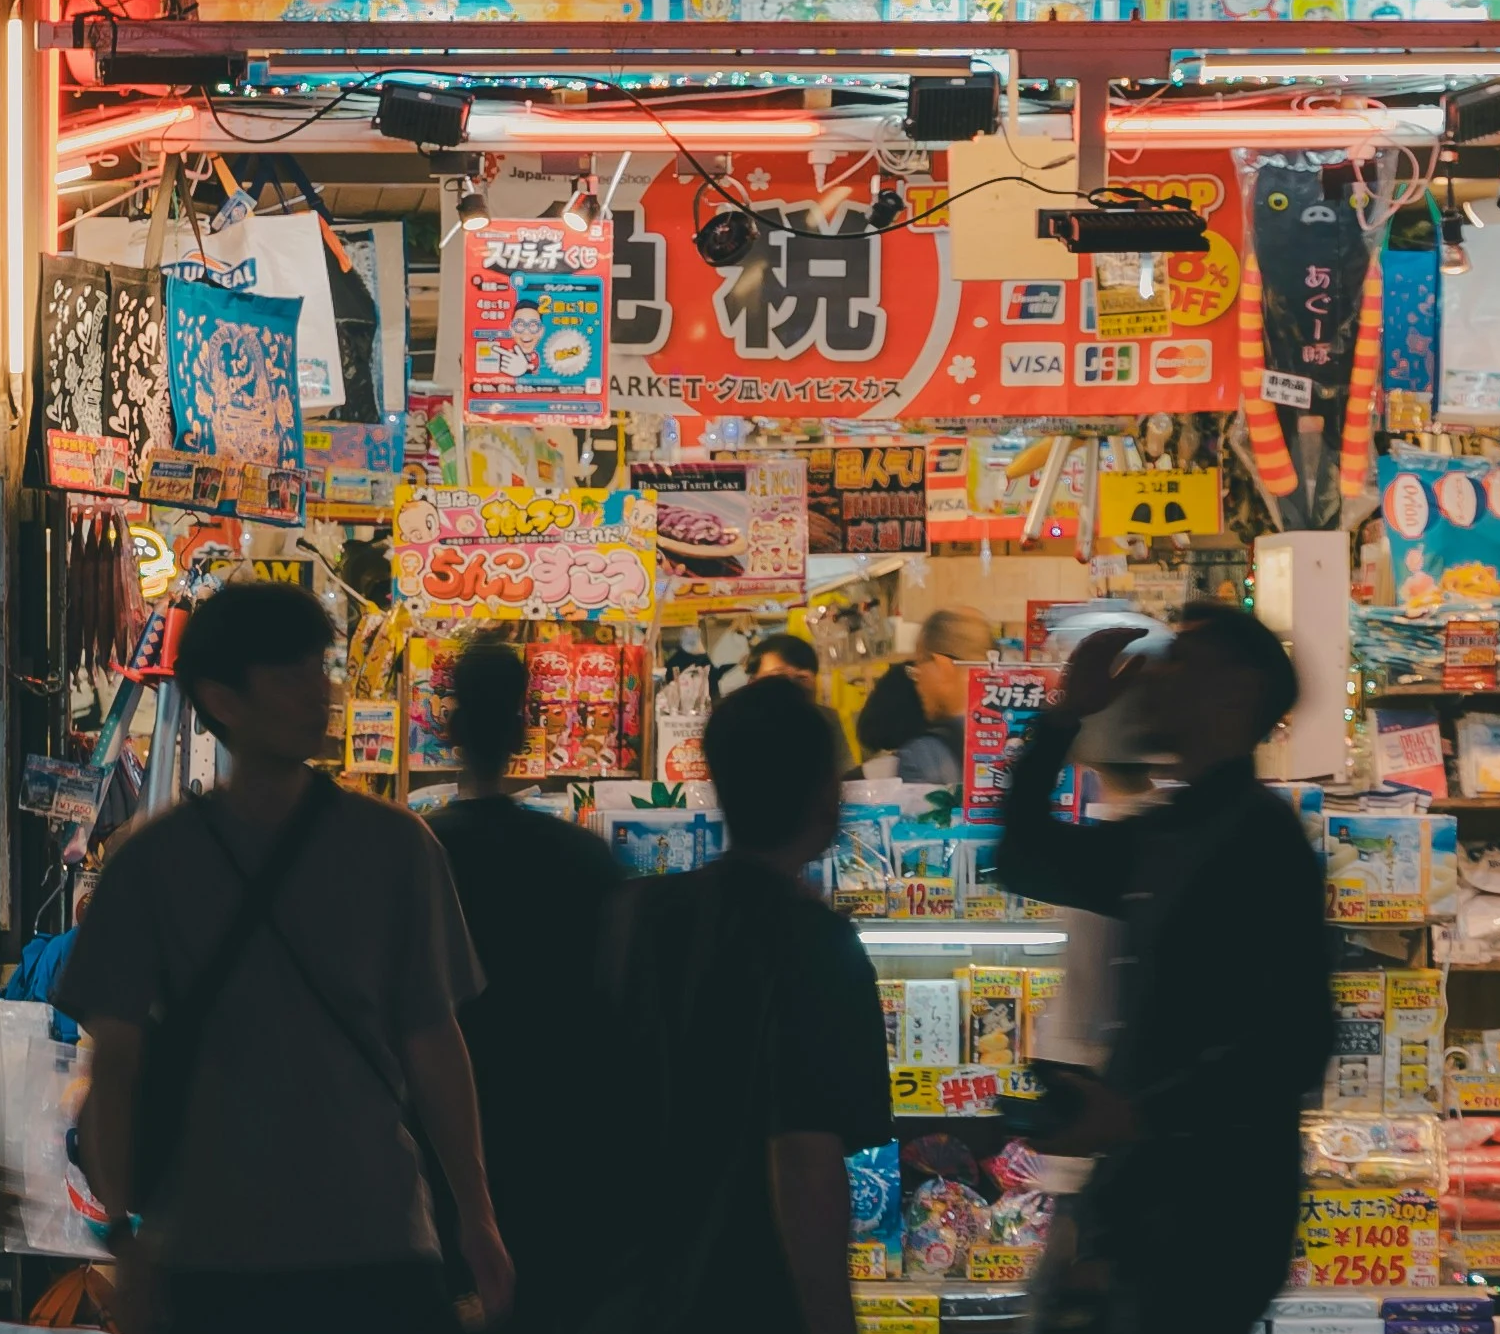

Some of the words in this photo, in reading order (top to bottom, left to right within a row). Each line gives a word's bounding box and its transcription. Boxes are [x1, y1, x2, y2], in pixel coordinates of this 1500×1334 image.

[483, 241, 600, 269] スクラッチくじ
[1008, 355, 1061, 375] VISA
[1081, 348, 1133, 381] JCB
[435, 490, 482, 509] 当店の
[1301, 1194, 1388, 1223] 大ちんすこう
[1334, 1225, 1409, 1248] ¥1408
[1314, 1255, 1407, 1286] ¥2565
